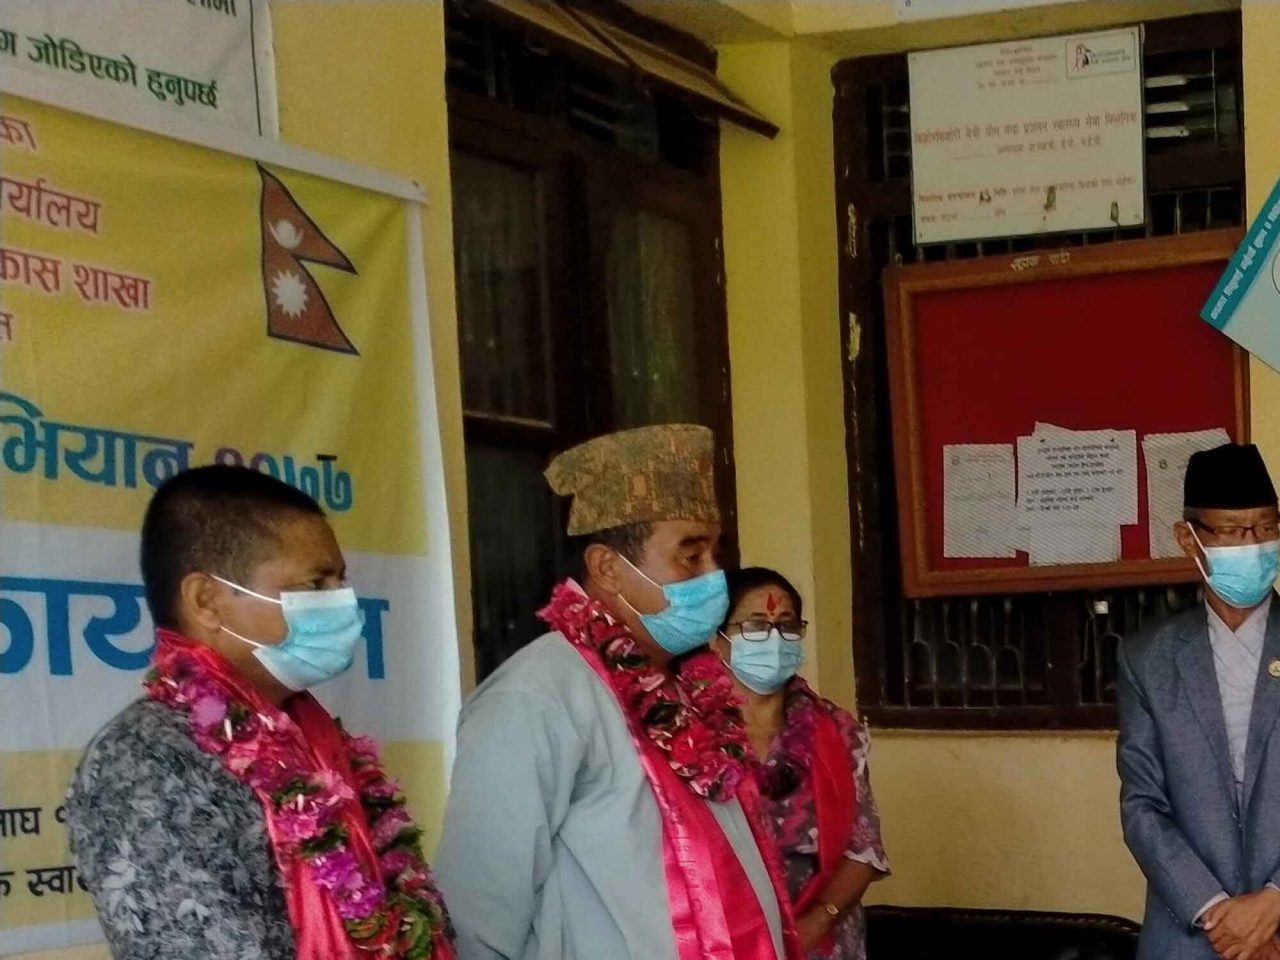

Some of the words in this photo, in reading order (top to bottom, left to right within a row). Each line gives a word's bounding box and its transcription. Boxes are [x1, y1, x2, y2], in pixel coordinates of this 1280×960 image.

[26, 31, 138, 87] जोडिएको
[145, 67, 219, 109] हुनुपर्छ
[0, 177, 102, 234] र्यालय
[72, 263, 151, 309] शाखा
